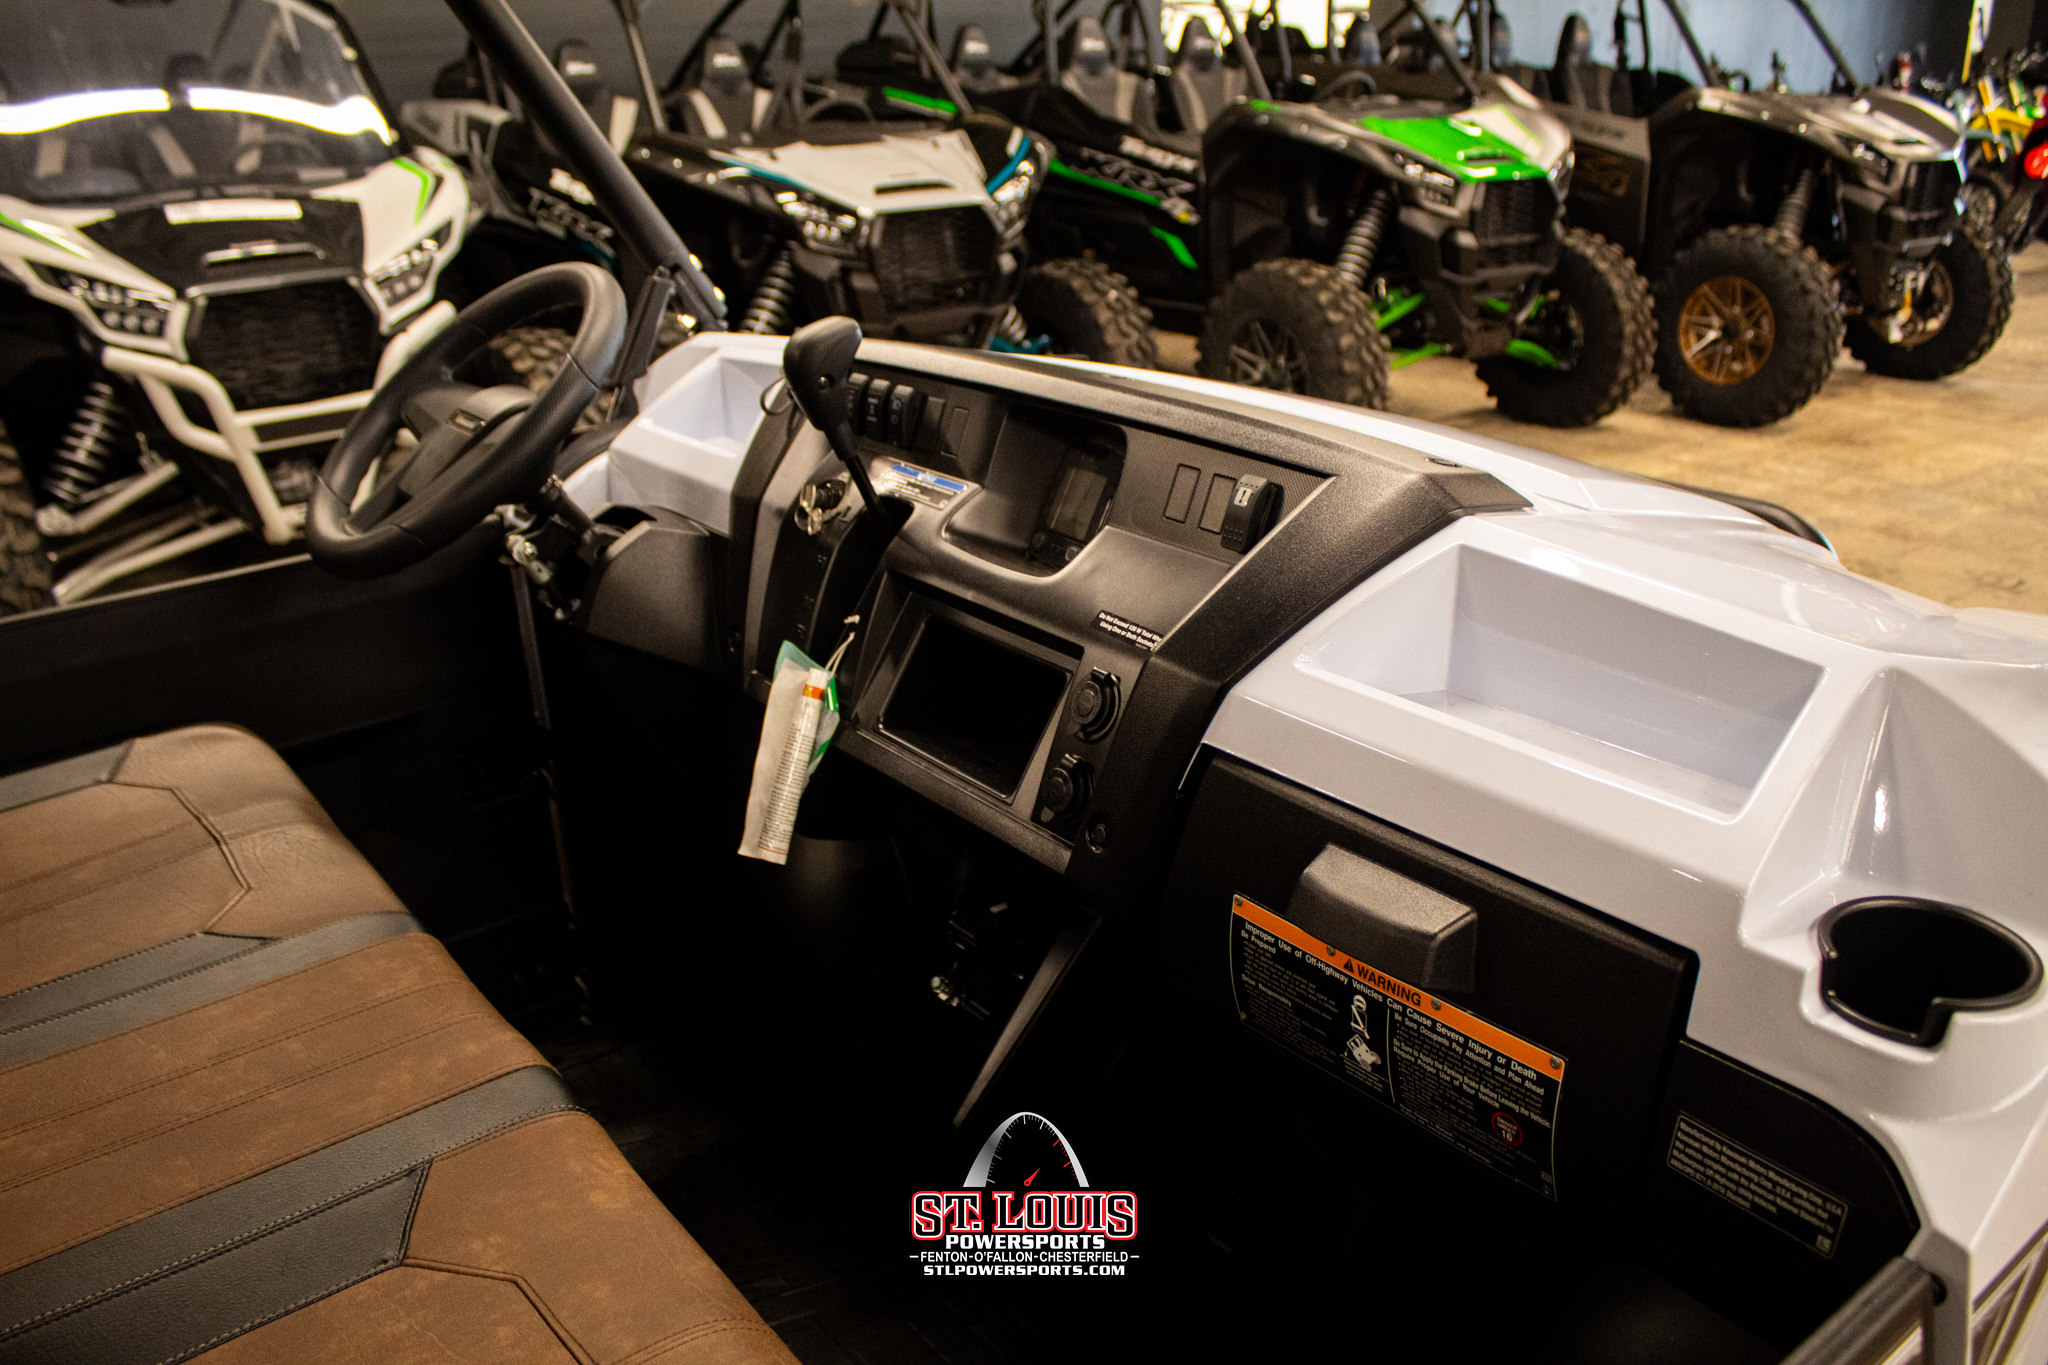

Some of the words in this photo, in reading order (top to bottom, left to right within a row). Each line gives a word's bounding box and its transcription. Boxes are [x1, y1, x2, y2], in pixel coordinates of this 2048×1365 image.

[1100, 621, 1112, 631] Using
[1126, 632, 1137, 640] Both
[1113, 618, 1129, 628] Exceed
[1241, 930, 1249, 939] Be
[1251, 935, 1276, 954] Prepared
[1245, 922, 1275, 943] Improper
[1278, 940, 1292, 953] Use
[1295, 950, 1302, 958] of
[1305, 955, 1348, 984] Off-Highway
[1352, 979, 1383, 1002] Vehicles
[1387, 998, 1402, 1012] Can
[1407, 1008, 1432, 1027] Cause
[1436, 1023, 1464, 1043] Severe
[1469, 1039, 1493, 1059] Injury
[1497, 1056, 1507, 1065] or
[1511, 1061, 1537, 1080] Death
[1358, 965, 1421, 1006] WARNING
[1394, 1012, 1402, 1022] Be
[1404, 1017, 1417, 1030] Sure
[1420, 1026, 1449, 1046] Occupants
[1452, 1042, 1463, 1054] Pay
[1465, 1050, 1491, 1068] Attention
[1494, 1065, 1506, 1075] and
[1508, 1071, 1522, 1084] Plan
[1524, 1080, 1544, 1095] Ahead
[1393, 1046, 1415, 1062] Require
[1417, 1059, 1436, 1074] Proper
[1439, 1071, 1451, 1082] Use
[1462, 1083, 1475, 1095] Your
[1478, 1092, 1500, 1108] Vehicle
[1502, 1130, 1513, 1142] 16
